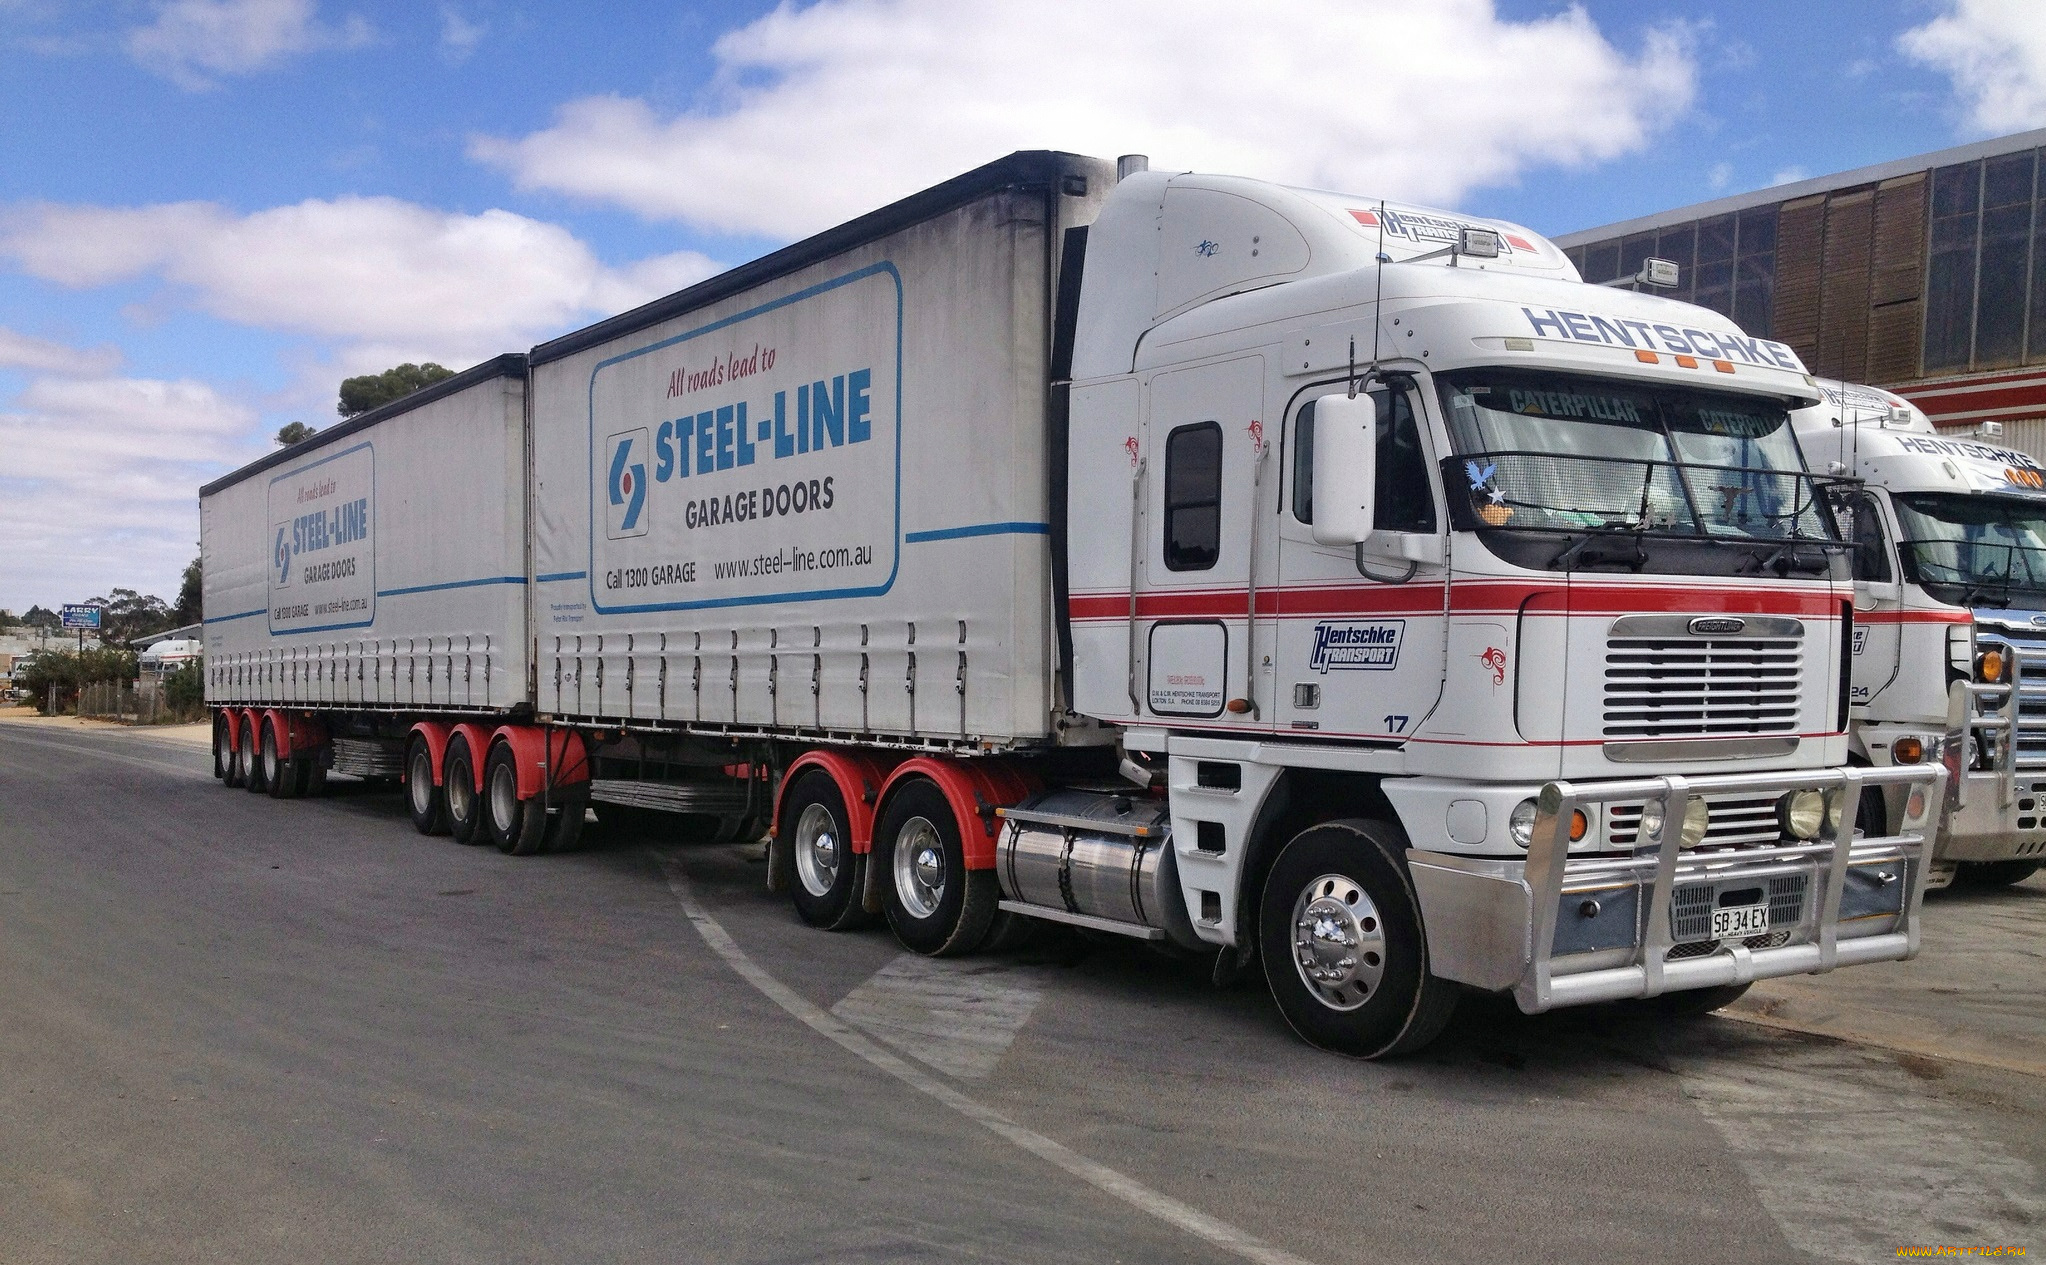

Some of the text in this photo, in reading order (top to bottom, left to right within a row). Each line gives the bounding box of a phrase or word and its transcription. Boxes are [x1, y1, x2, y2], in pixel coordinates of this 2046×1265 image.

[1382, 210, 1476, 235] Hentsch
[1402, 224, 1459, 242] TRANS
[1521, 307, 1798, 370] HENTSCHKE
[667, 343, 776, 399] All roads lead to
[1509, 388, 1641, 423] CATERPILLAR
[655, 368, 871, 483] STEEL-LINE
[1895, 436, 2038, 470] HENTSCHKE
[305, 482, 319, 502] roads
[319, 477, 330, 498] lead
[685, 476, 834, 530] GARAGE DOORS
[293, 498, 367, 556] STEEL-LINE
[304, 557, 356, 585] GARAGE DOORS
[606, 545, 872, 590] Call 1300 GARAGE www.steel-line.com.au
[292, 604, 309, 618] GARAGE
[1314, 626, 1396, 664] Hentschke
[1321, 647, 1394, 674] TRANSPORT
[1383, 715, 1409, 733] 17
[1714, 908, 1767, 933] SB 34 EX
